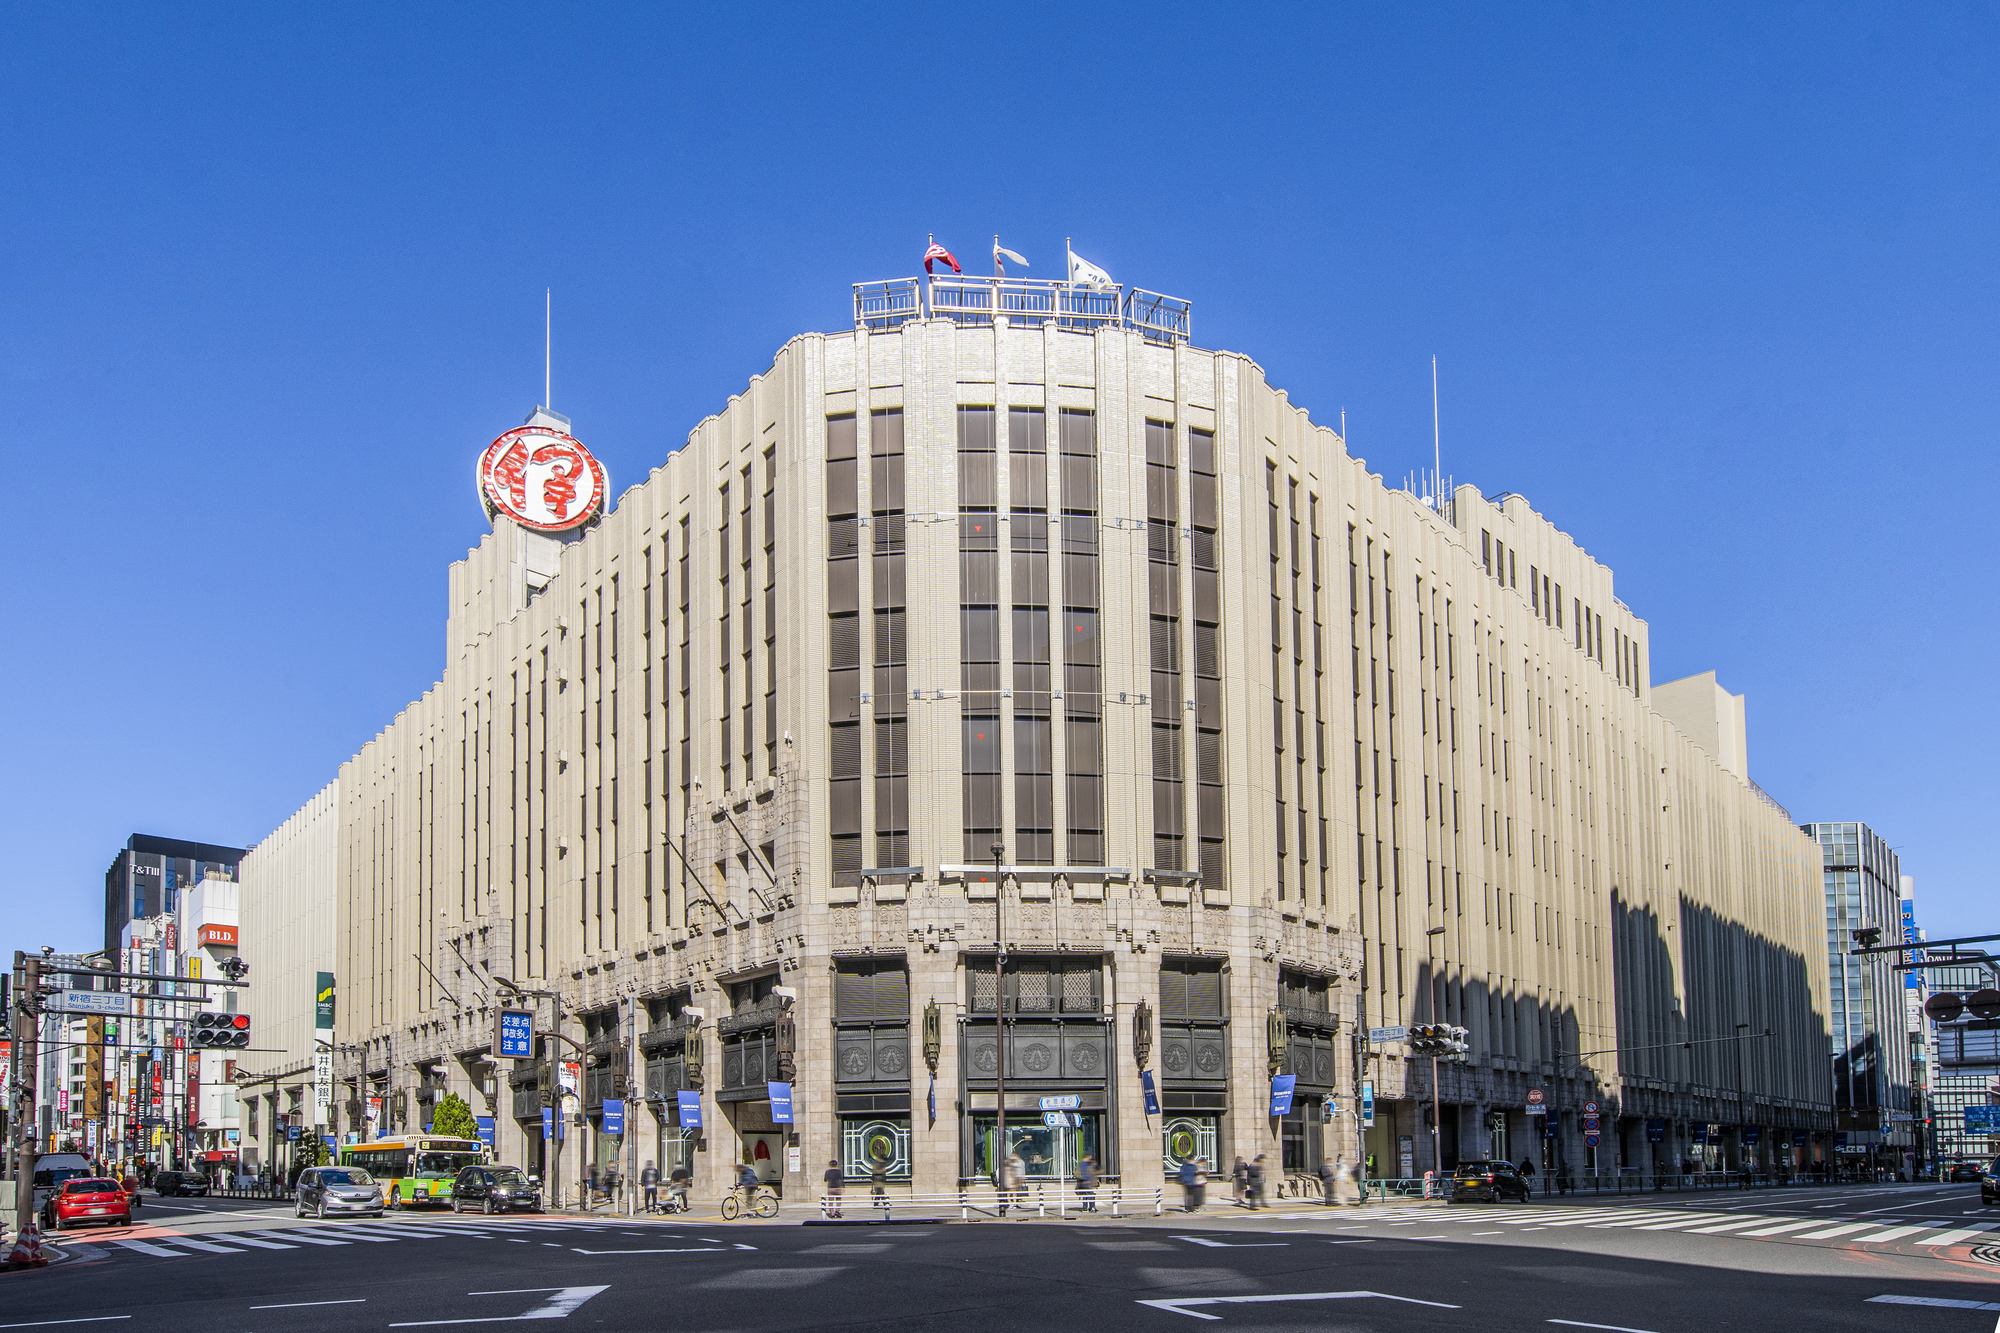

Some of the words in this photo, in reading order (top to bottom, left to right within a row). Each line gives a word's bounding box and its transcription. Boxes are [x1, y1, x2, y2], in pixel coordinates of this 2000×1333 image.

[1902, 912, 1912, 921] 3
[209, 930, 234, 942] BLD.
[68, 993, 125, 1006] 新宿三丁目
[67, 1002, 94, 1010] Shinjuku
[502, 1016, 530, 1028] 交差点
[502, 1028, 529, 1039] 事故多し
[502, 1040, 528, 1051] 注意
[318, 1052, 330, 1108] 井住友銀行
